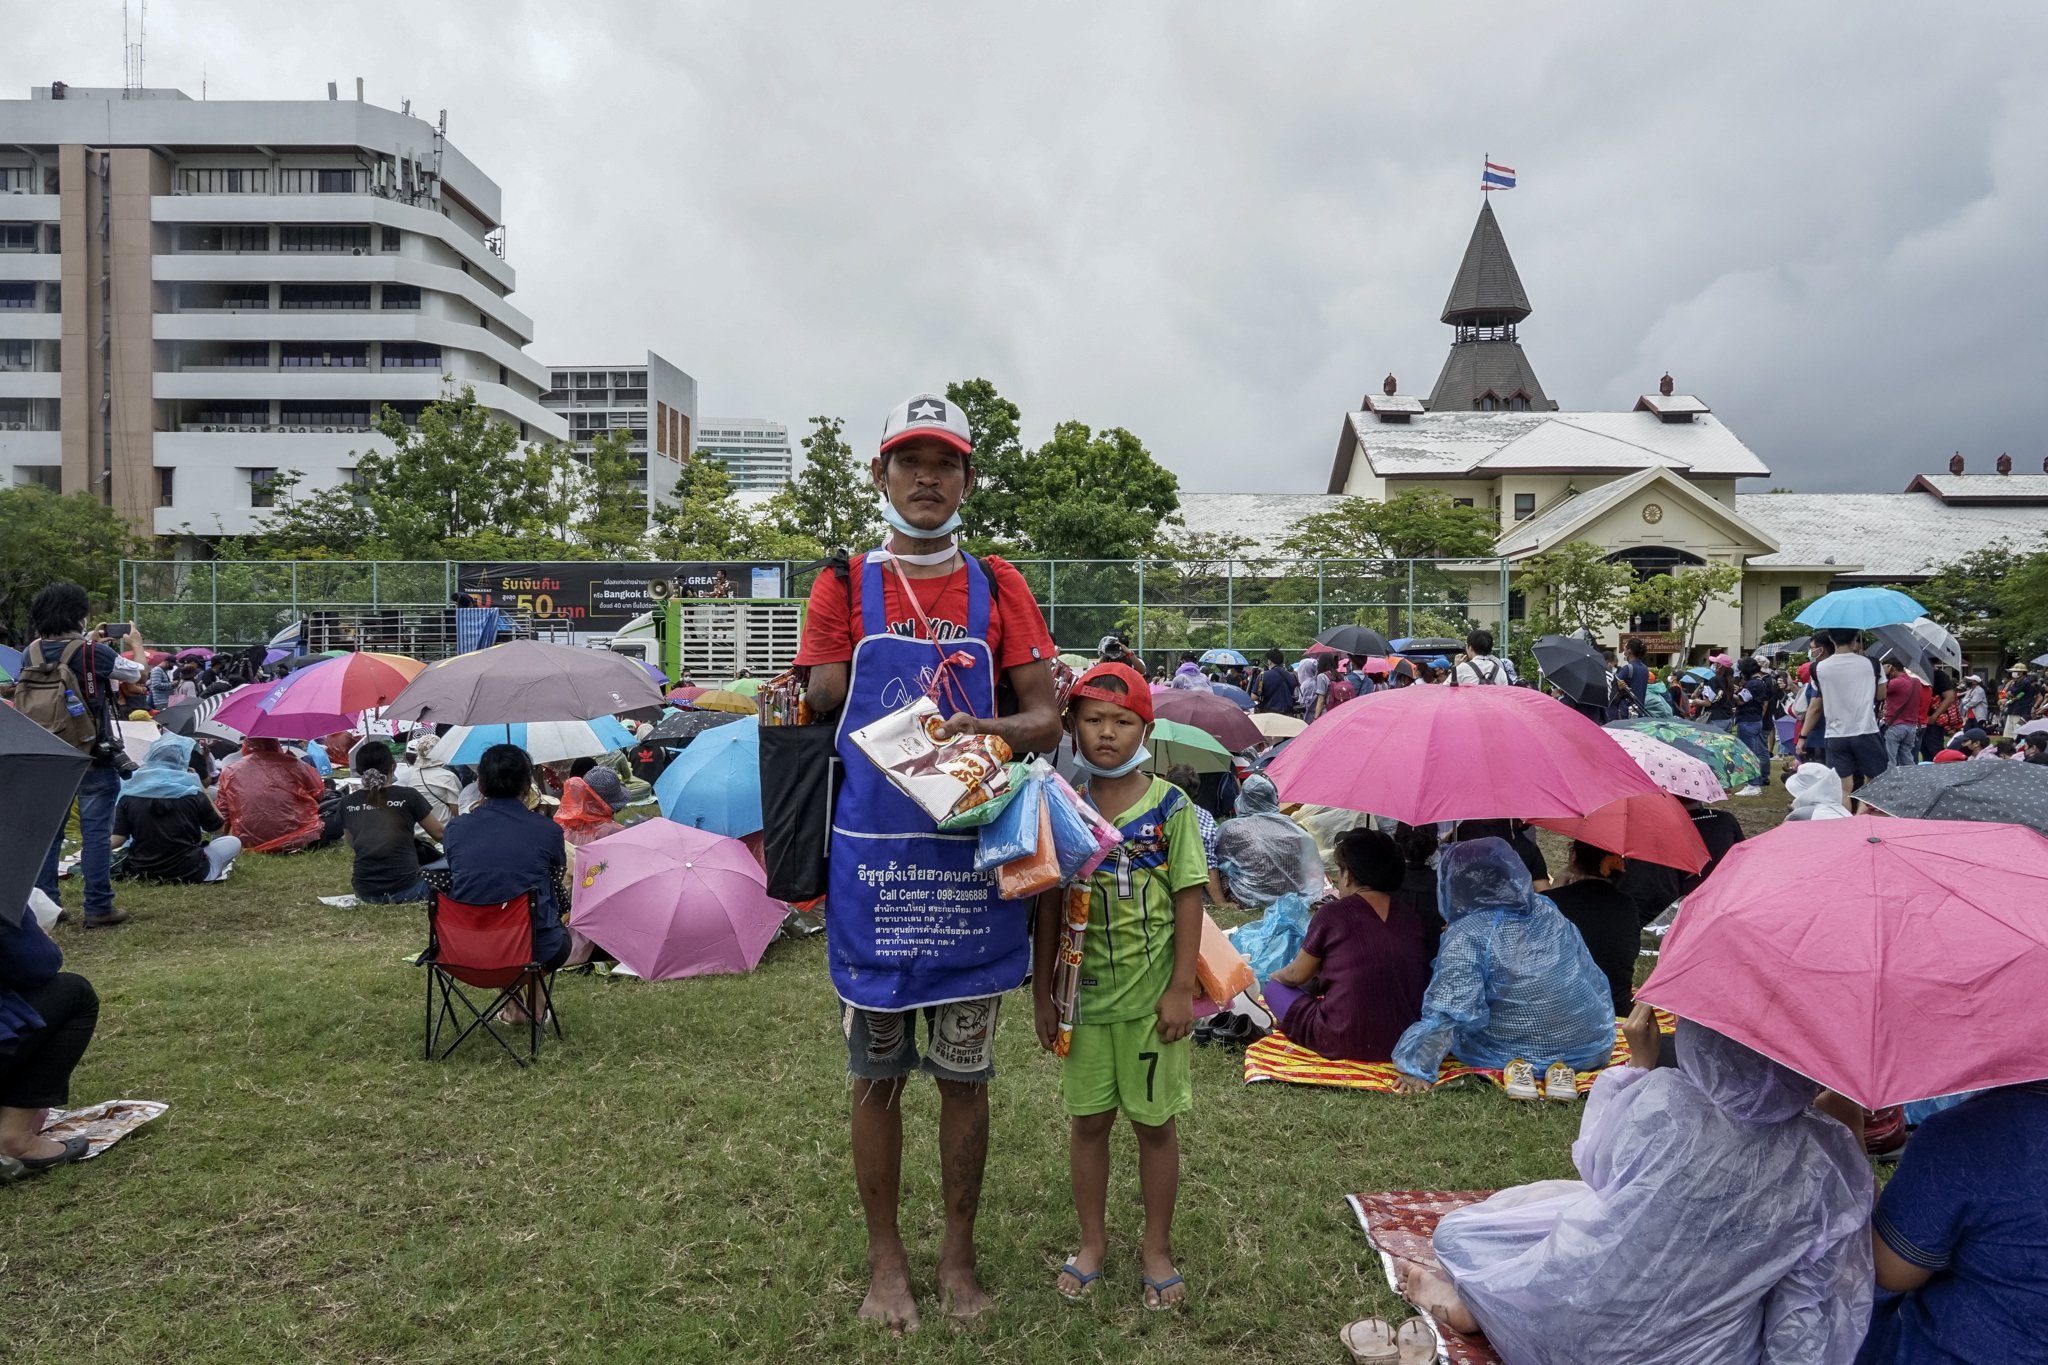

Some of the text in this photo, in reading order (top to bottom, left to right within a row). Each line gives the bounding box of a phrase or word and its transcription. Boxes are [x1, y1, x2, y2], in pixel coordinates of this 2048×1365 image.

[502, 577, 560, 590] รับเงินคืน
[604, 590, 641, 600] Bangkok
[517, 594, 553, 618] 50
[880, 888, 897, 900] Call
[899, 888, 929, 900] Center
[937, 888, 988, 901] 098-2896888
[985, 926, 991, 934] 3
[935, 1045, 983, 1065] PRISONER
[951, 1046, 983, 1056] ANOTHER
[1138, 1051, 1159, 1103] 7
